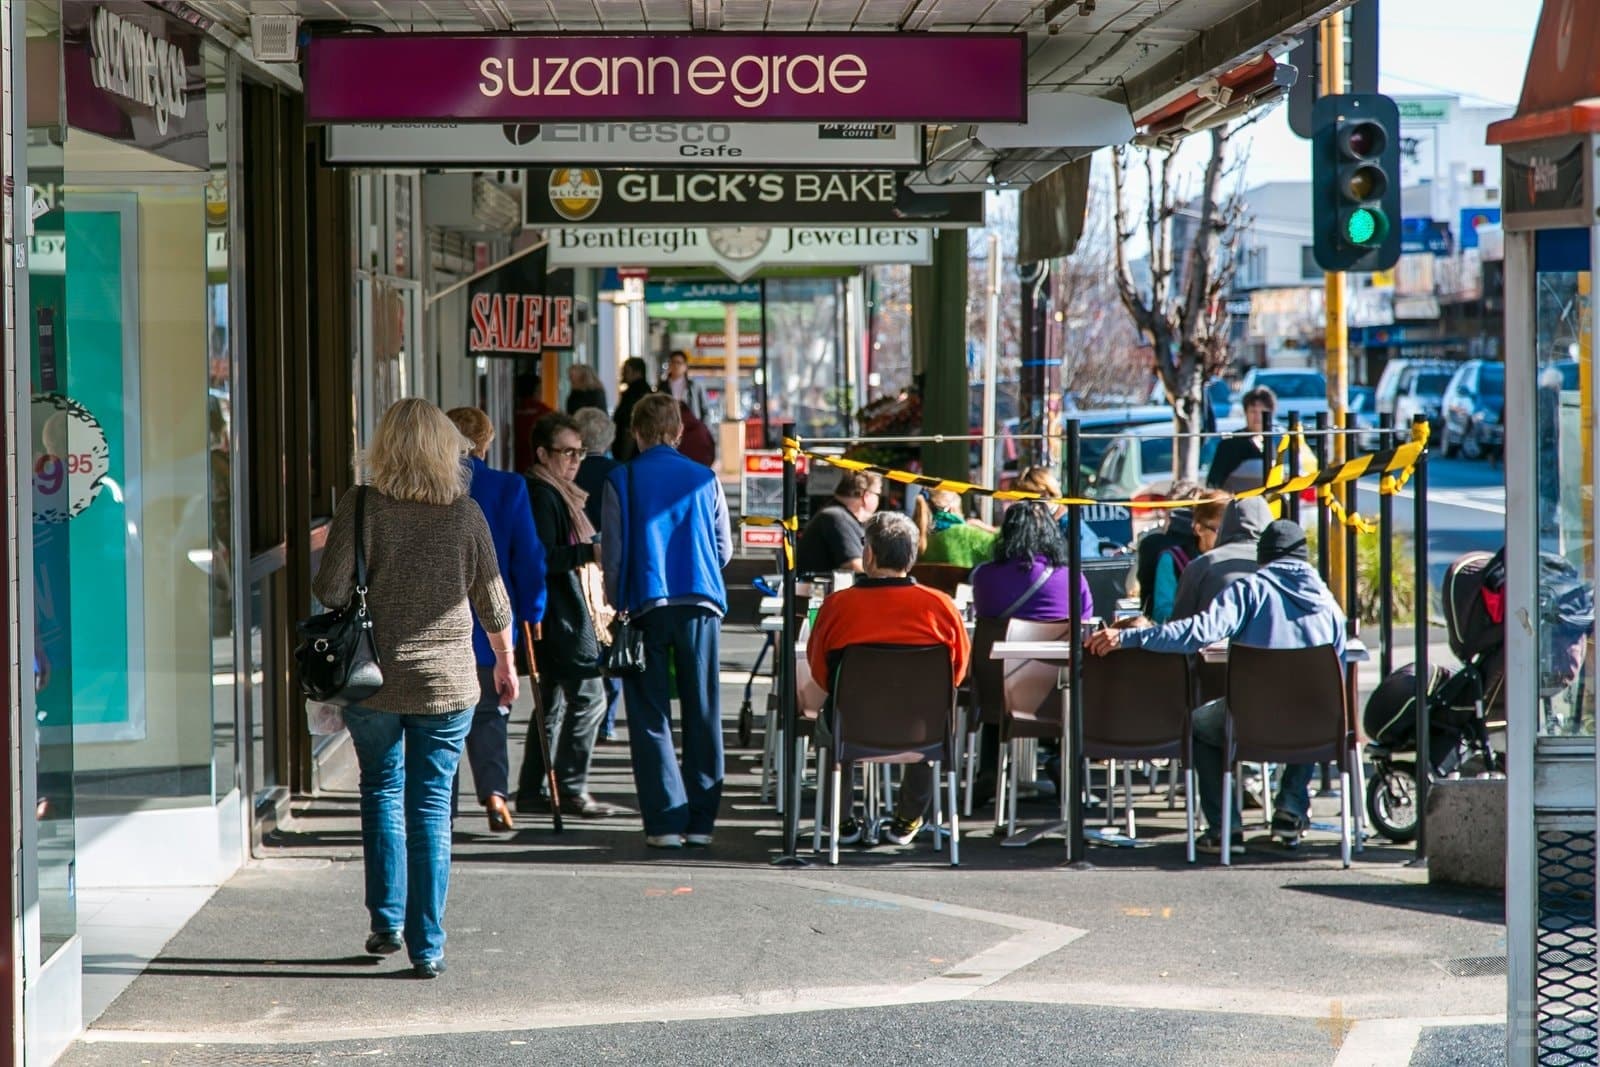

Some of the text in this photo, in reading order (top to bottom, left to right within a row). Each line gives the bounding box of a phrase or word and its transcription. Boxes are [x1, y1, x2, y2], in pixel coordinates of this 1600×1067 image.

[679, 144, 742, 157] Cafe
[617, 173, 784, 202] GLICK'S
[560, 227, 919, 253] Bentleigh Jewellers
[470, 291, 542, 353] SALE
[67, 453, 93, 474] 95
